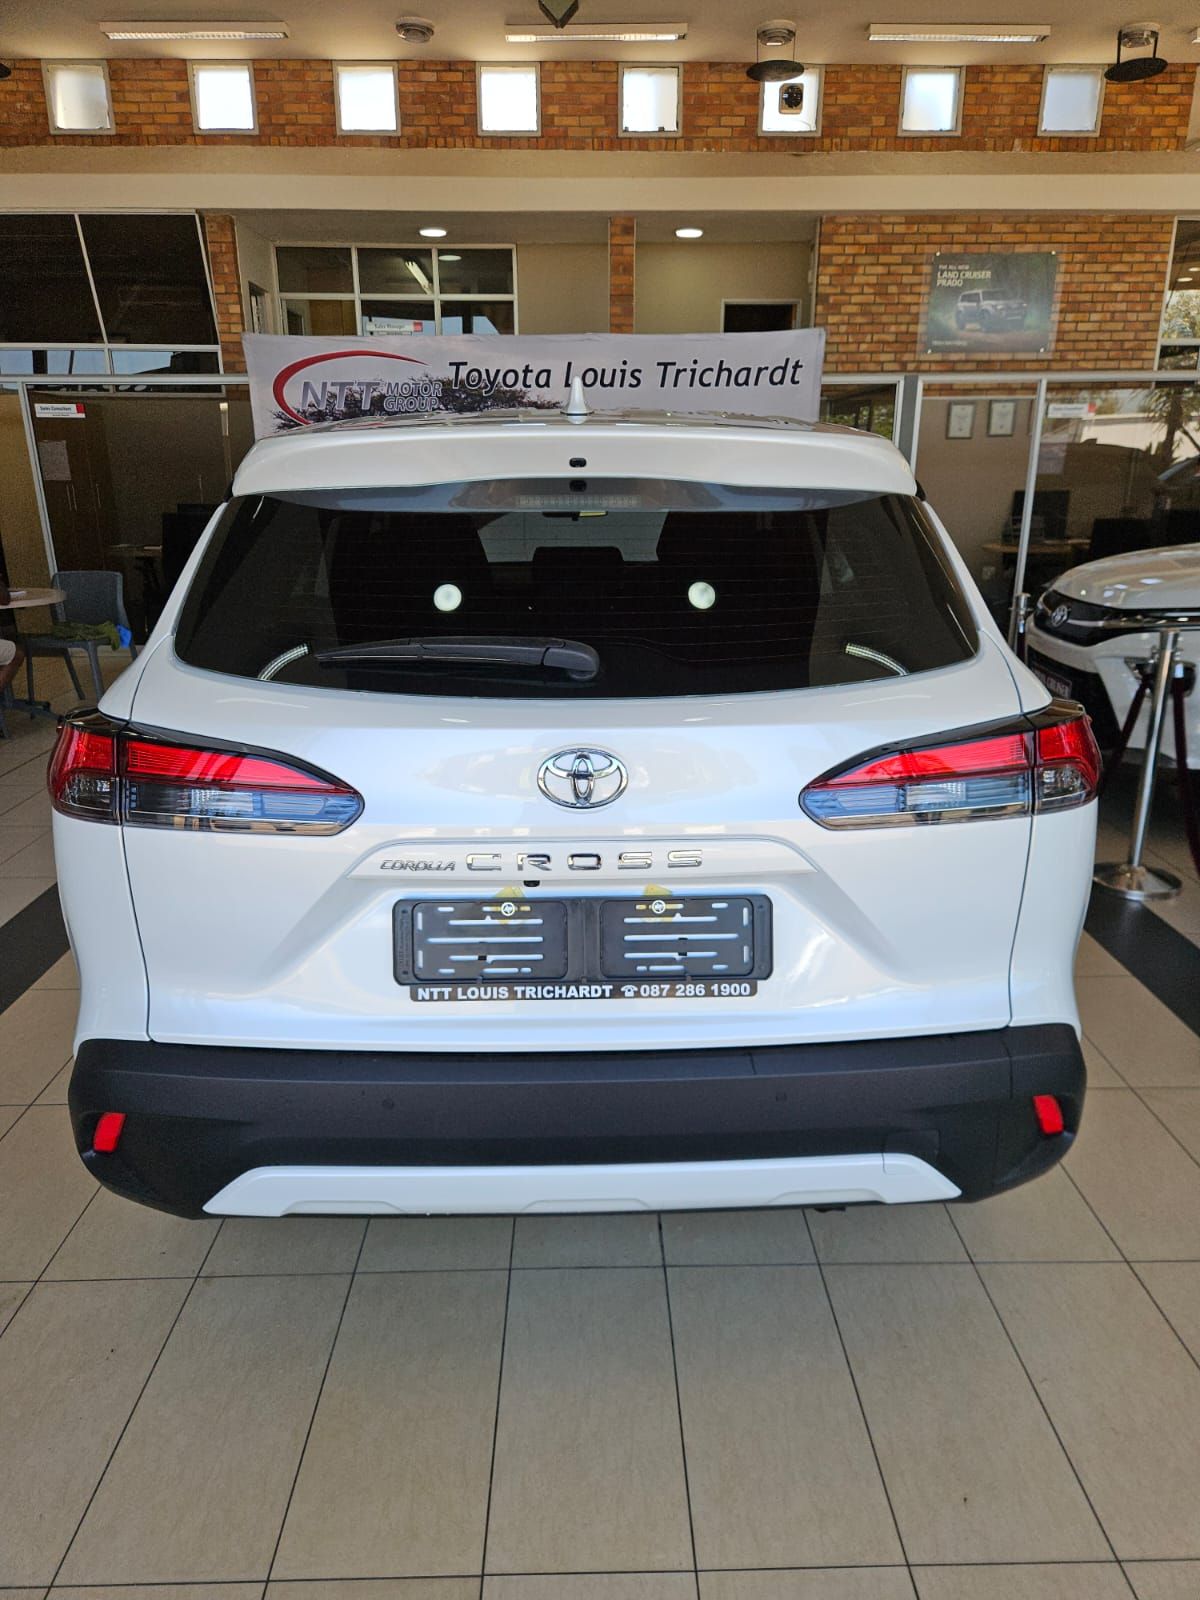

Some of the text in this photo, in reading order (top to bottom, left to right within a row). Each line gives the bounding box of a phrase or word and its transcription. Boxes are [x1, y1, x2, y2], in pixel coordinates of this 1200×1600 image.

[936, 279, 964, 287] PRADO
[937, 271, 992, 279] LAND CRUISER
[448, 357, 804, 397] Toyota Louis Trichardt
[301, 381, 381, 410] NTT
[385, 381, 442, 398] MOTOR
[384, 397, 440, 412] GROUP
[380, 850, 703, 872] COROLLA CROSS
[417, 983, 751, 1001] NTT LOUIS TRICHARDT 087 286 1900
